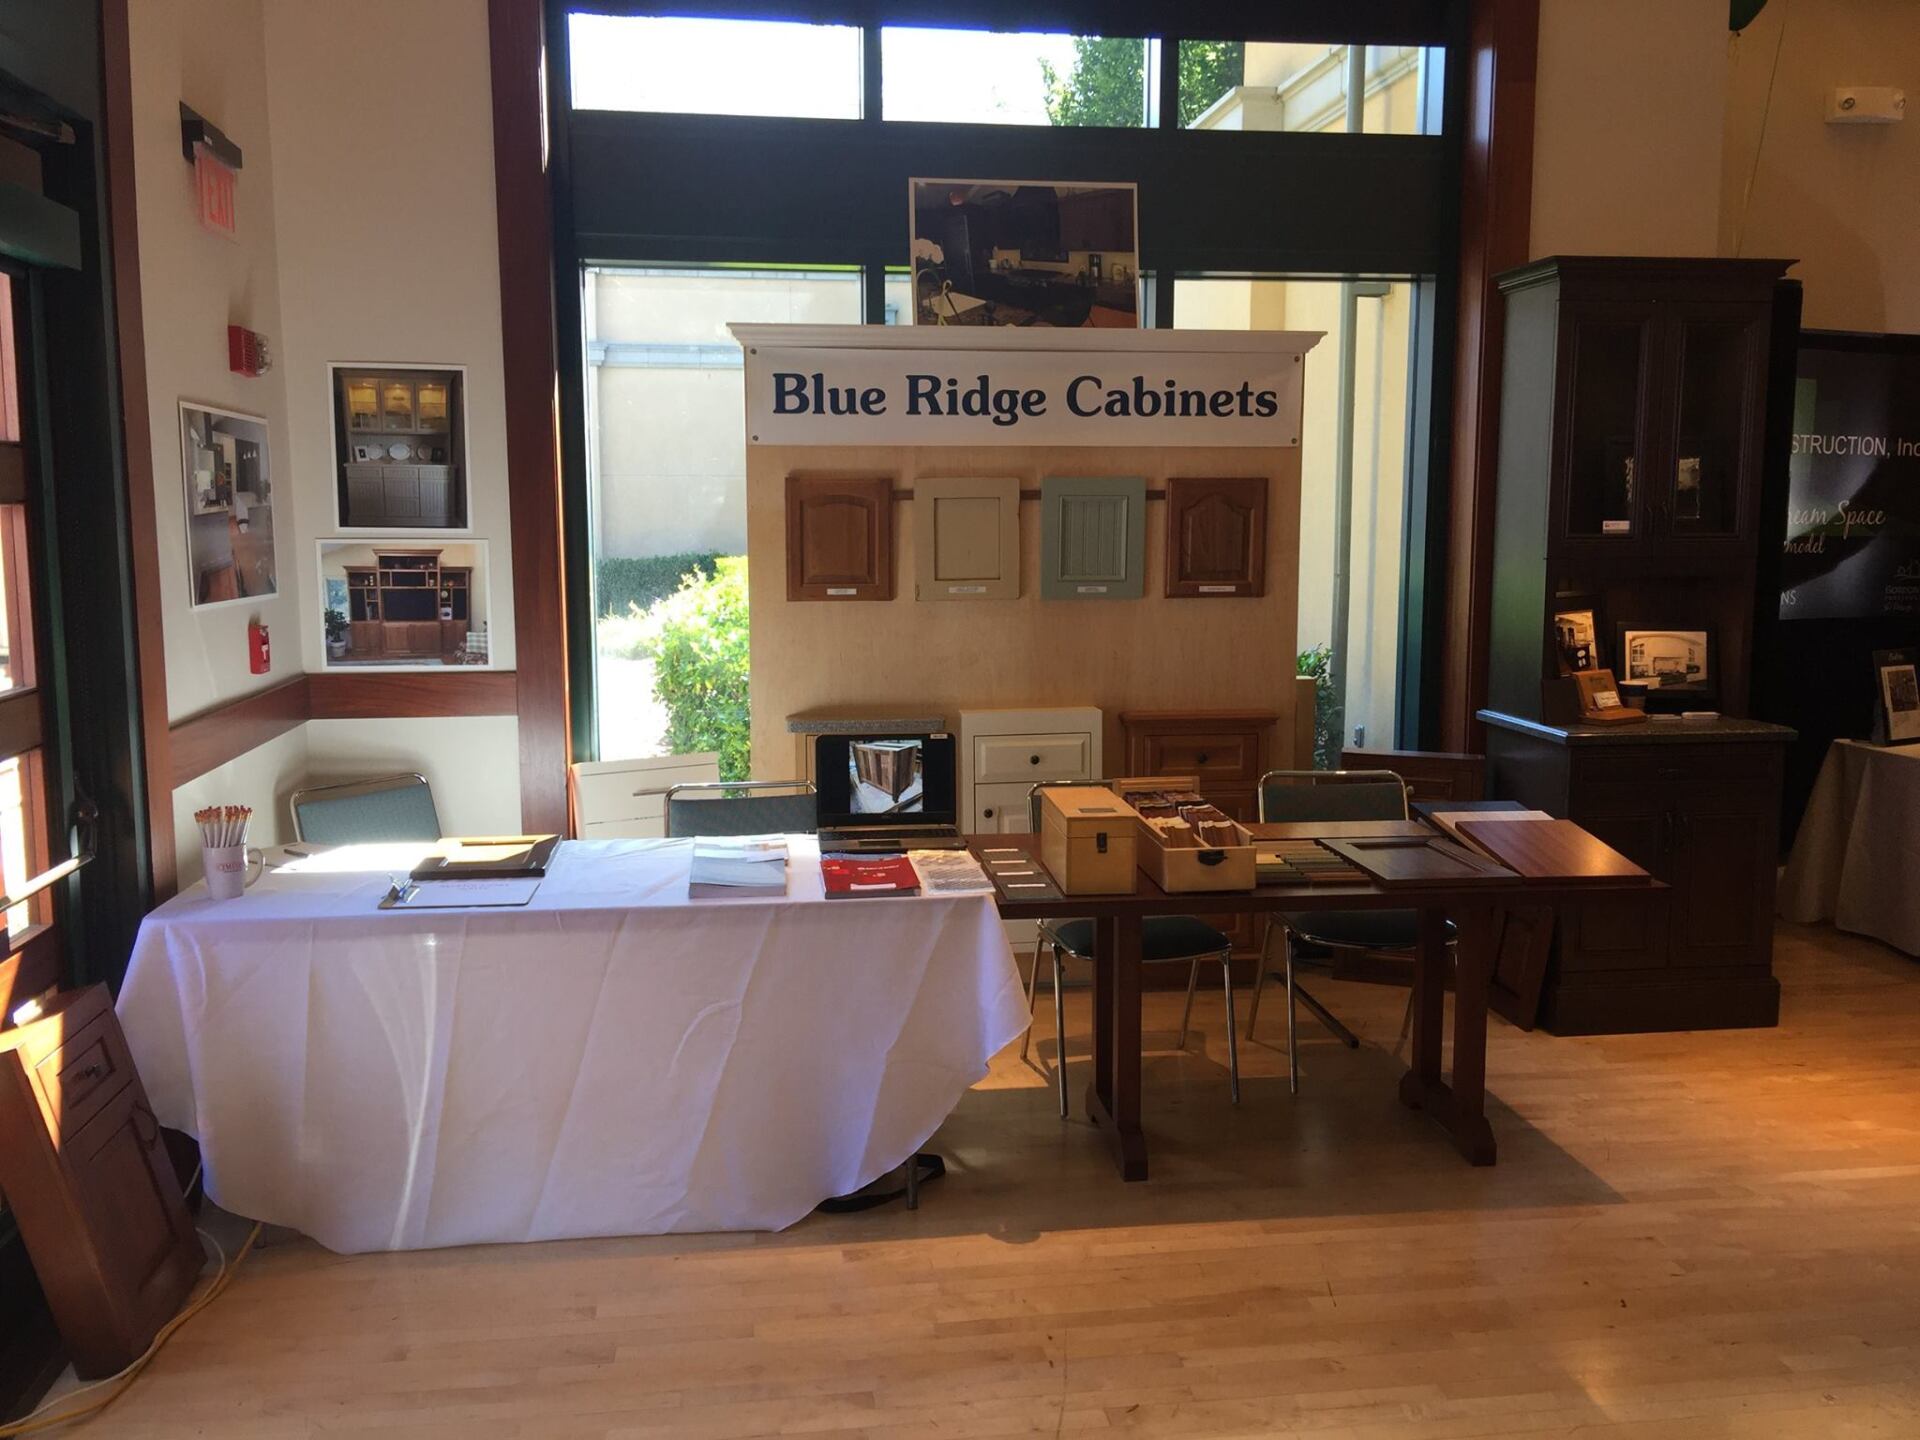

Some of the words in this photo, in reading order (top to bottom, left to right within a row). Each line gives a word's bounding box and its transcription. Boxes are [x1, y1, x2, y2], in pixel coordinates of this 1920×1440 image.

[772, 373, 887, 415] Blue
[905, 375, 1047, 426] Ridge
[1066, 375, 1278, 417] Cabinets
[1791, 434, 1891, 459] STRUCTION,
[1789, 508, 1829, 526] eam
[1834, 499, 1887, 540] Space
